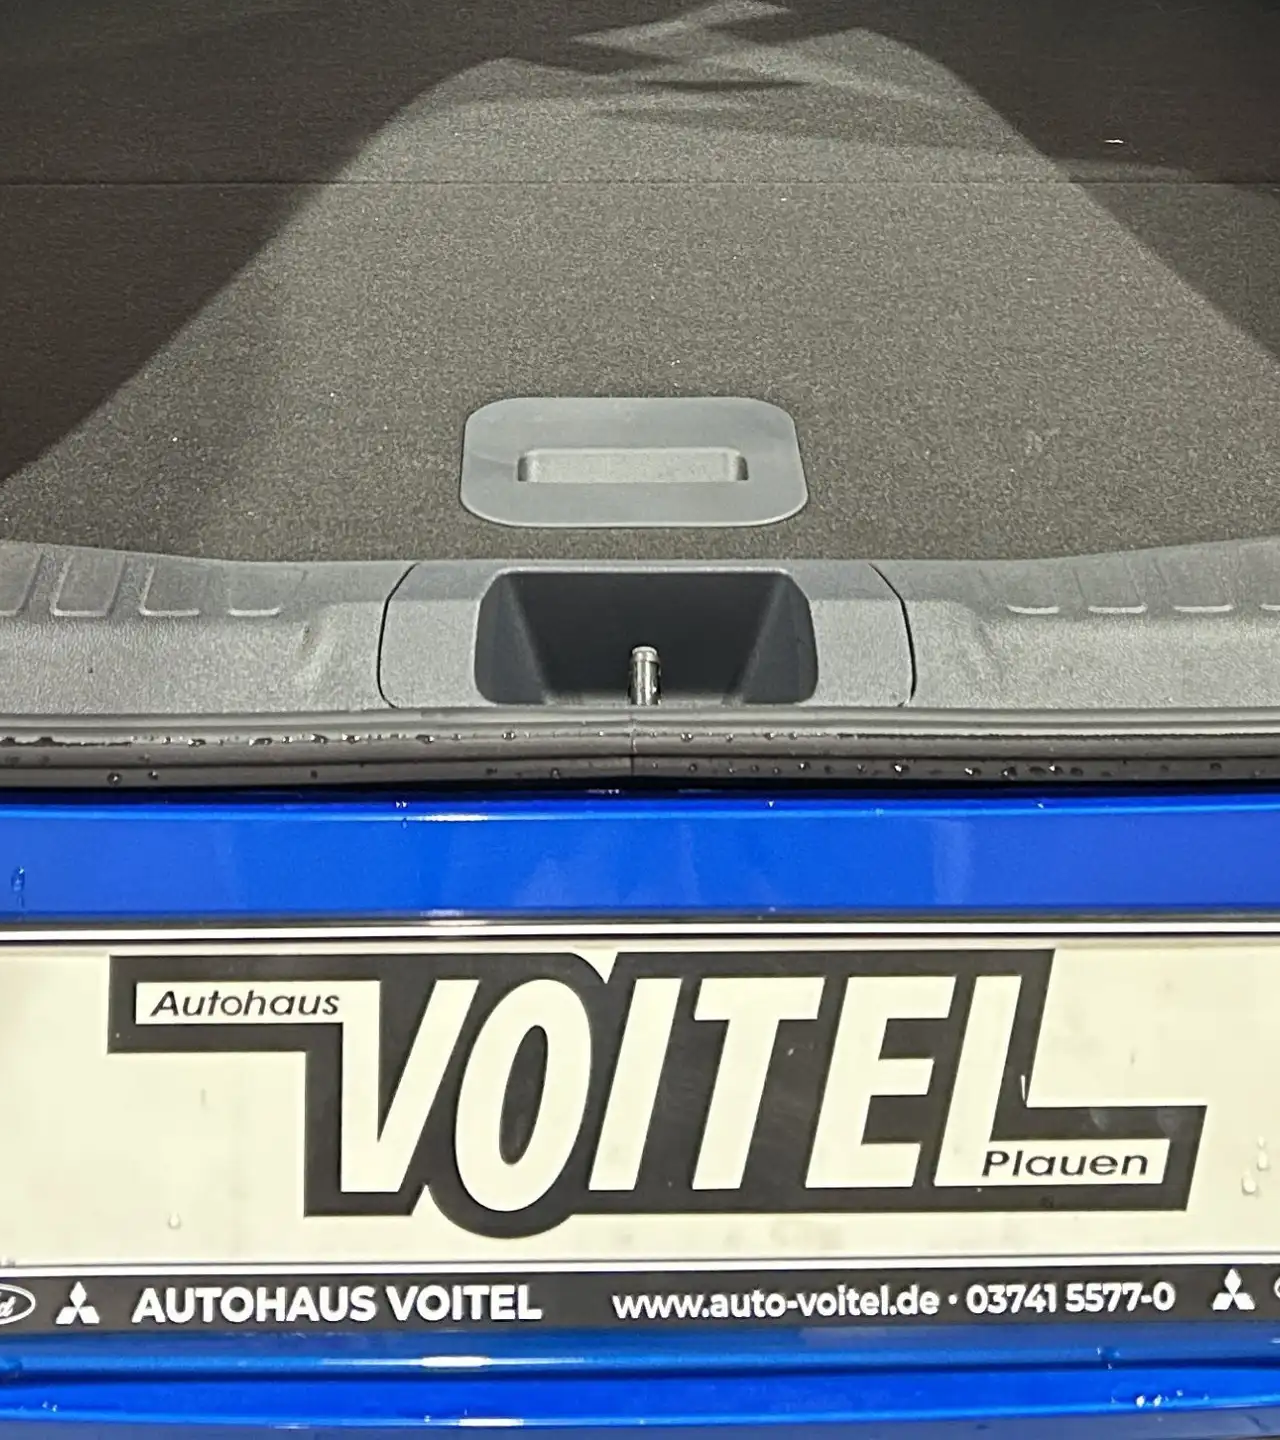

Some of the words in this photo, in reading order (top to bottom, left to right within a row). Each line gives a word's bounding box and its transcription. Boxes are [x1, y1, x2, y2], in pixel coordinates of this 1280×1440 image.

[150, 990, 339, 1017] Autohaus
[338, 976, 1169, 1212] VOITEL
[981, 1150, 1148, 1177] Plauen
[131, 1285, 378, 1324] AUTOHAUS
[385, 1284, 543, 1321] VOITEL
[612, 1284, 941, 1319] www.auto-voitel.de
[965, 1283, 1057, 1314] 03741
[1065, 1281, 1176, 1313] 5577-0
